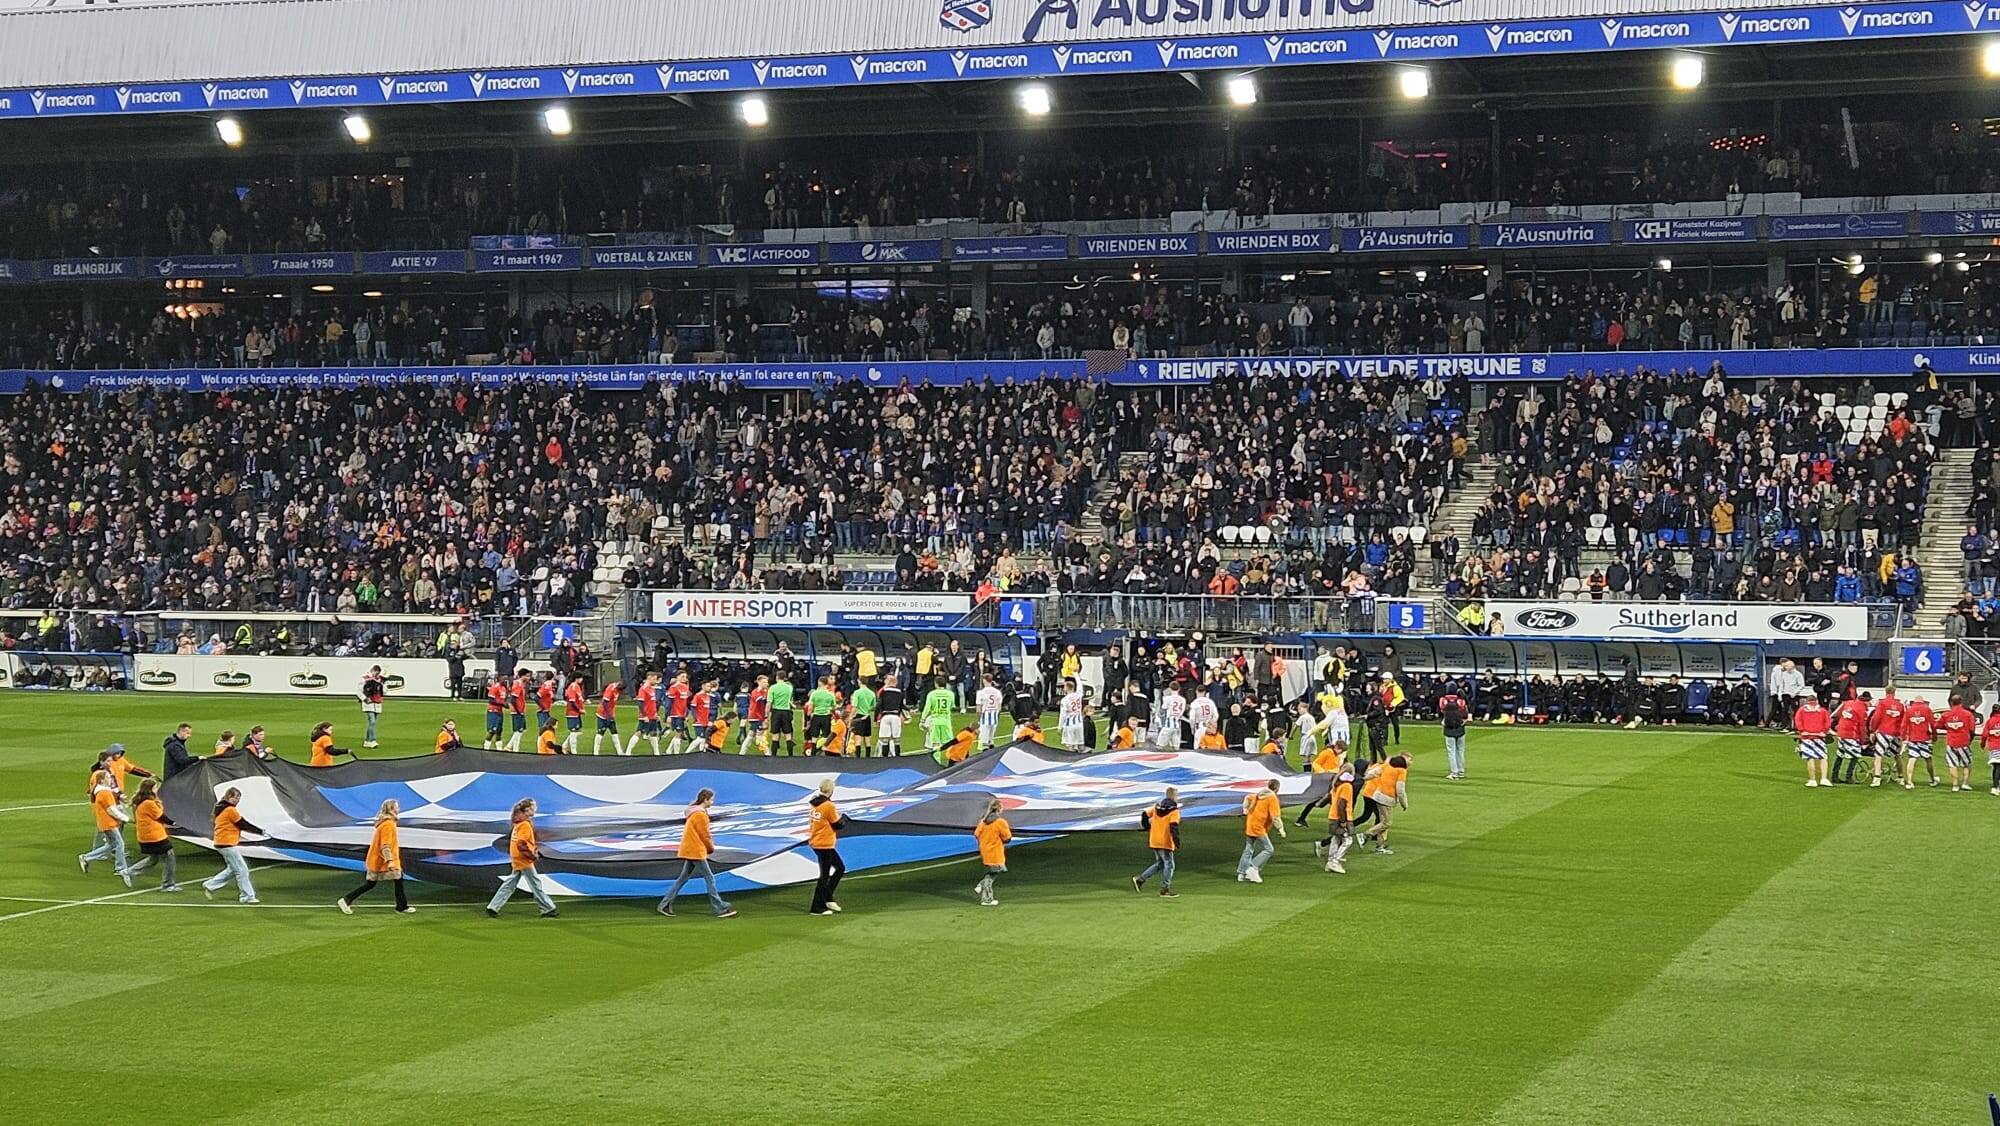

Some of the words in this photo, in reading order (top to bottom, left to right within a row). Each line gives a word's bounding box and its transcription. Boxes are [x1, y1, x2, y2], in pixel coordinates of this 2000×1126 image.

[1740, 16, 1810, 33] macron
[1862, 10, 1934, 27] macron
[1506, 28, 1572, 44] macron
[1622, 22, 1690, 39] macron
[1284, 38, 1347, 55] macron
[1394, 33, 1459, 49] macron
[1072, 48, 1132, 64] macron
[1176, 42, 1238, 59] macron
[869, 58, 926, 74] macron
[969, 53, 1028, 69] macron
[674, 68, 729, 83] macron
[771, 64, 827, 78] macron
[396, 79, 448, 94] macron
[487, 75, 540, 90] macron
[580, 72, 634, 87] macron
[131, 89, 181, 104] macron
[217, 86, 268, 101] macron
[306, 82, 358, 97] macron
[46, 93, 95, 109] macron
[1217, 236, 1288, 249] VRIENDEN
[1292, 234, 1320, 247] BOX
[1377, 230, 1454, 246] Ausnutria
[1516, 226, 1594, 242] Ausnutria
[1087, 239, 1157, 252] VRIENDEN
[1160, 238, 1188, 250] BOX
[391, 257, 421, 268] AKTIE
[492, 256, 505, 266] 21
[507, 256, 537, 265] maart
[538, 254, 563, 264] 1967
[596, 252, 645, 264] VOETBAL
[646, 252, 655, 262] &
[656, 250, 693, 262] ZAKEN
[716, 248, 748, 262] VHC
[752, 248, 810, 260] ACTIFOOD
[53, 263, 123, 276] BELANGRIJK
[272, 260, 279, 270] 7
[311, 258, 335, 268] 1950
[755, 369, 769, 380] fol
[770, 371, 794, 380] eare
[796, 371, 810, 380] en
[1243, 360, 1291, 378] VAN
[1423, 357, 1521, 376] TRIBUNE
[174, 374, 190, 387] op!
[201, 374, 220, 384] Wol
[222, 376, 234, 384] no
[236, 374, 248, 384] ris
[610, 370, 628, 382] lân
[629, 370, 645, 381] fan
[686, 600, 814, 618] INTERSPORT
[1010, 604, 1024, 622] 4
[1401, 607, 1414, 627] 5
[1526, 609, 1565, 628] Ford
[1618, 608, 1738, 627] Sutherland
[1780, 613, 1822, 632] Ford
[552, 628, 564, 646] 3
[1916, 650, 1932, 672] 6
[937, 698, 948, 709] 13
[988, 694, 994, 705] 5
[1200, 704, 1210, 716] 19
